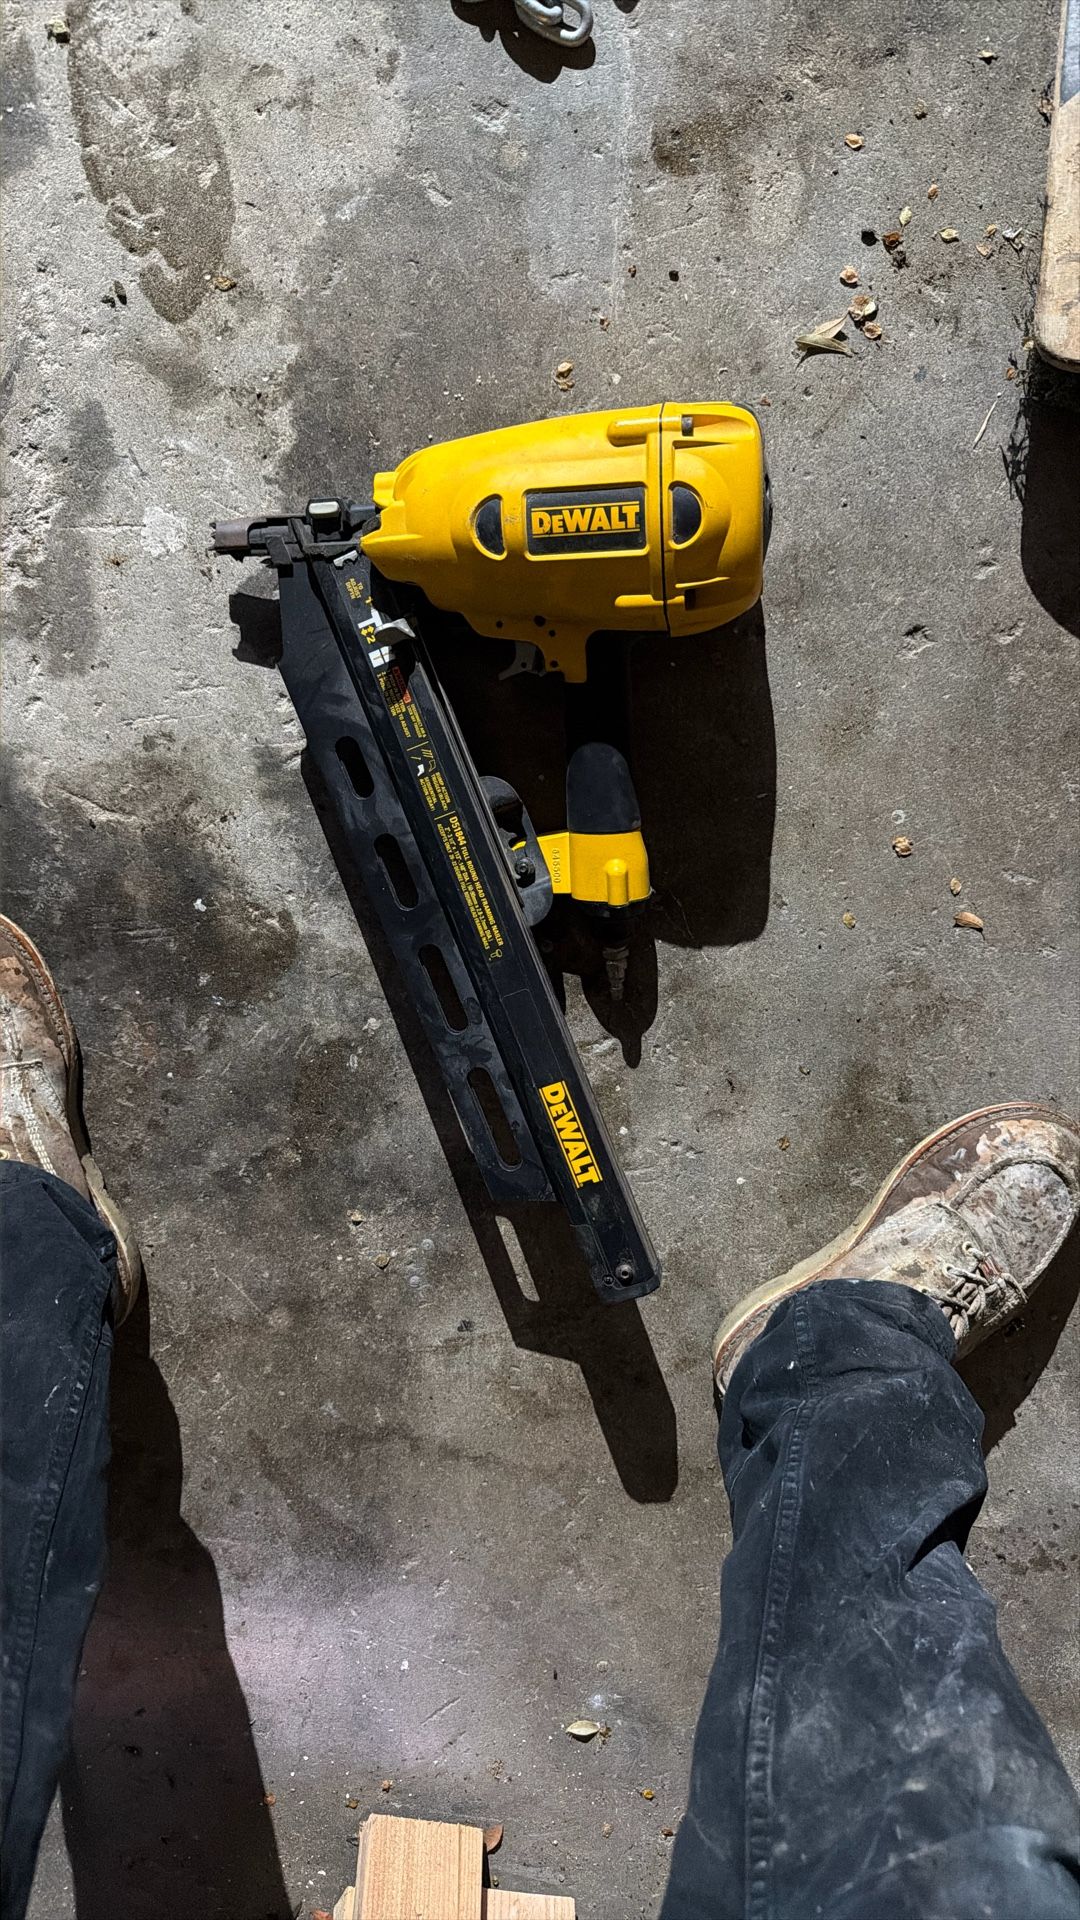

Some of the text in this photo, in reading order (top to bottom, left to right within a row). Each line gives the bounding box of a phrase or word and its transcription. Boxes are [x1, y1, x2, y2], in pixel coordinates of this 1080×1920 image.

[531, 504, 640, 535] DEWALT
[356, 582, 363, 590] TO
[365, 634, 376, 644] 2
[440, 785, 451, 803] ACTION
[448, 815, 504, 946] D51844 FULL ROUND HEAD FRAMING NAILER
[541, 1081, 600, 1185] DEWALT
